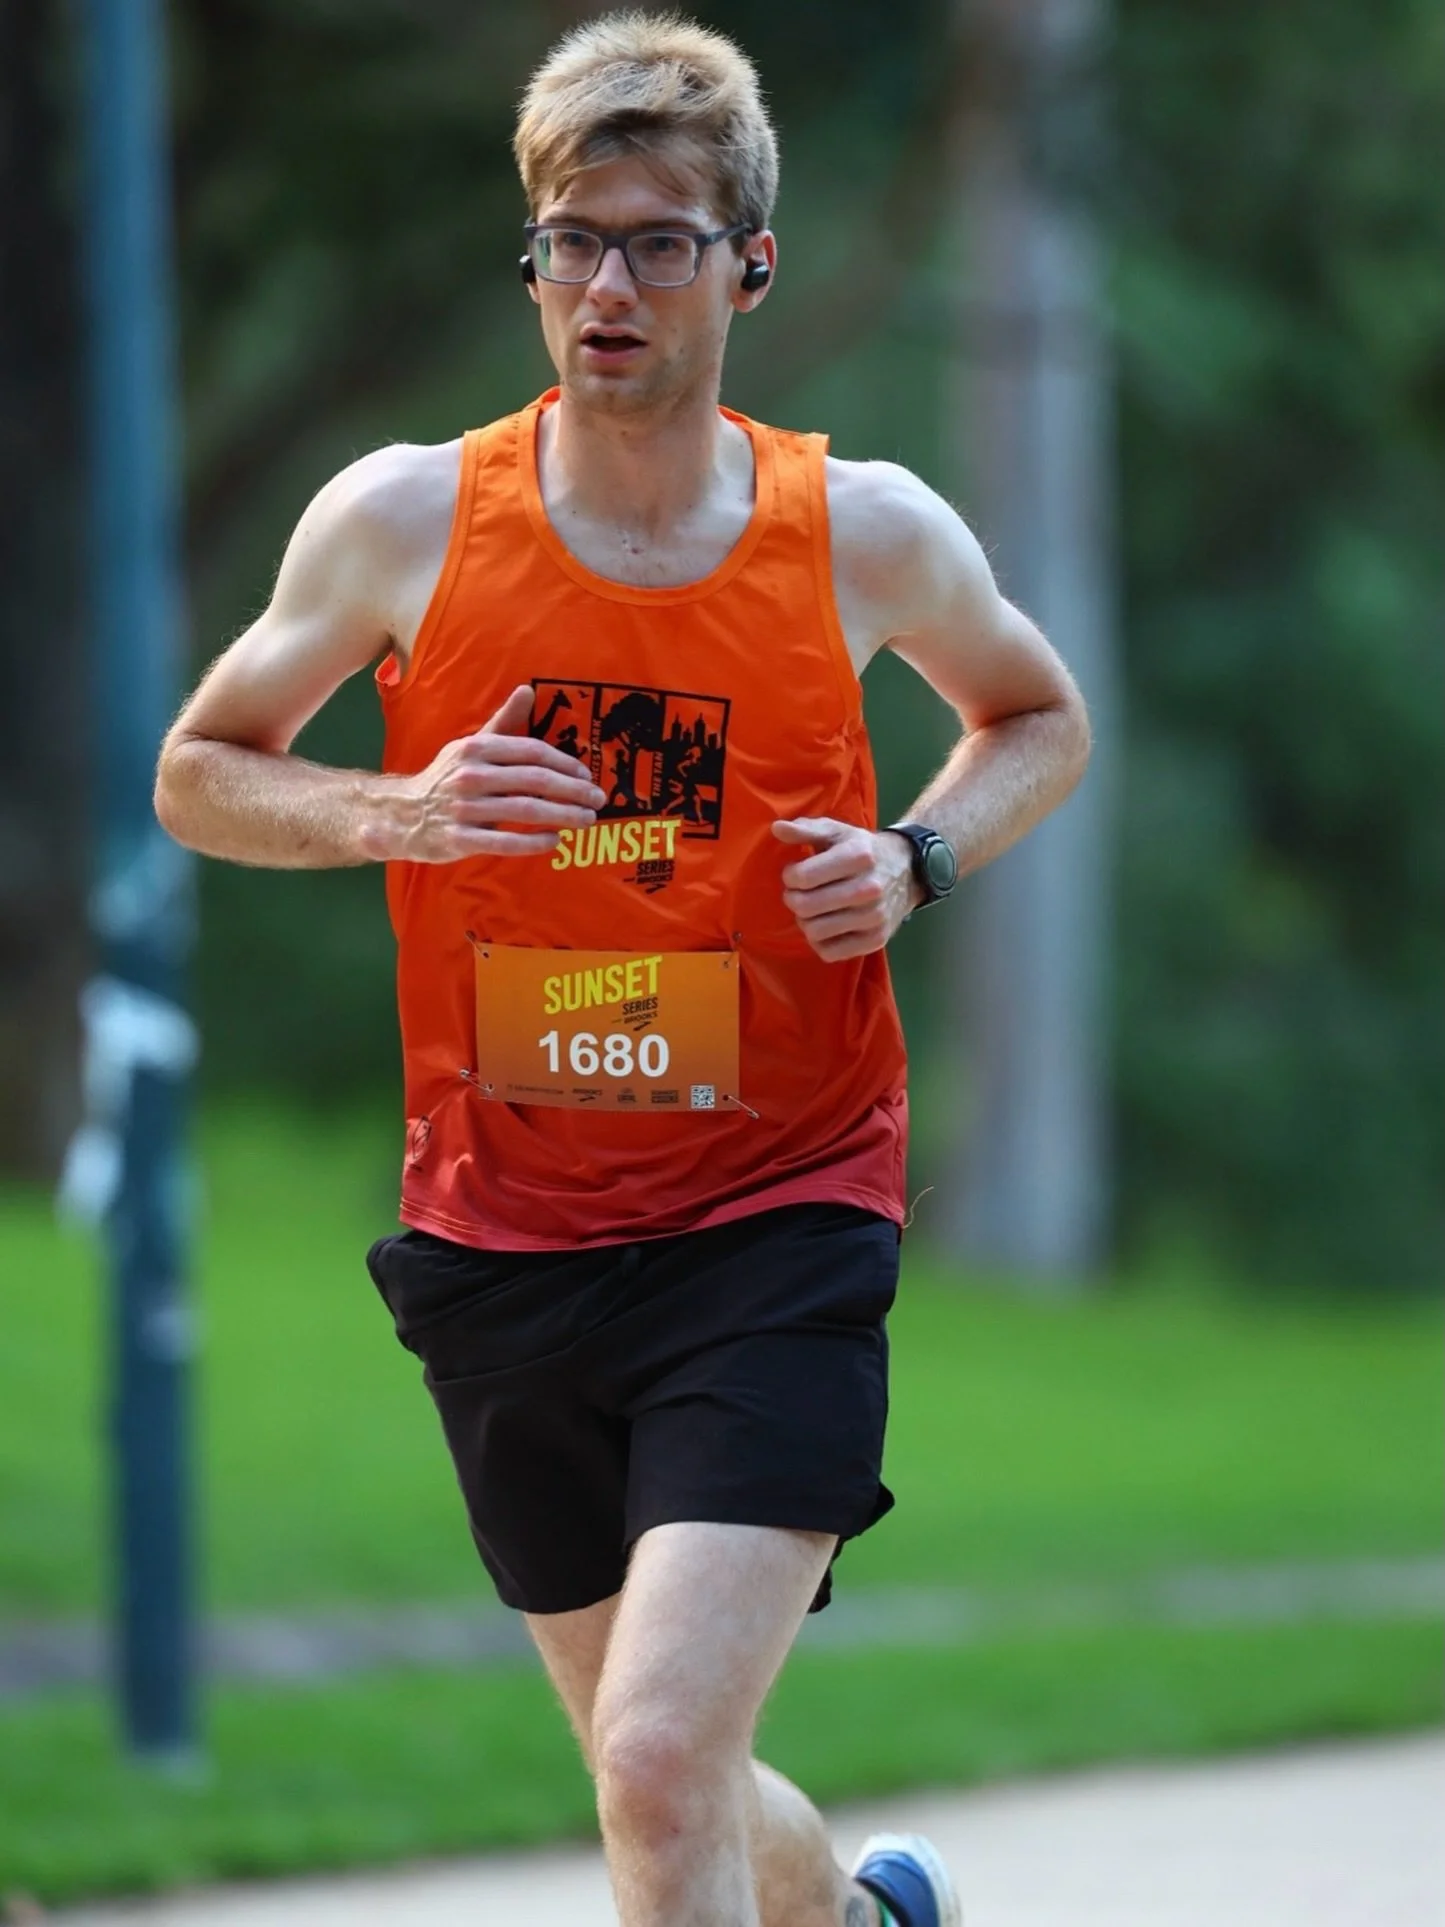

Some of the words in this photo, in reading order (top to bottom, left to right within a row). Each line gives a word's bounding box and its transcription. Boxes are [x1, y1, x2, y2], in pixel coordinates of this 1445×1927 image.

[591, 719, 601, 751] PARK
[551, 819, 681, 870] SUNSET
[636, 859, 675, 876] SERIES
[543, 955, 662, 1014] SUNSET
[622, 997, 658, 1015] SERIES
[538, 1030, 669, 1077] 1680
